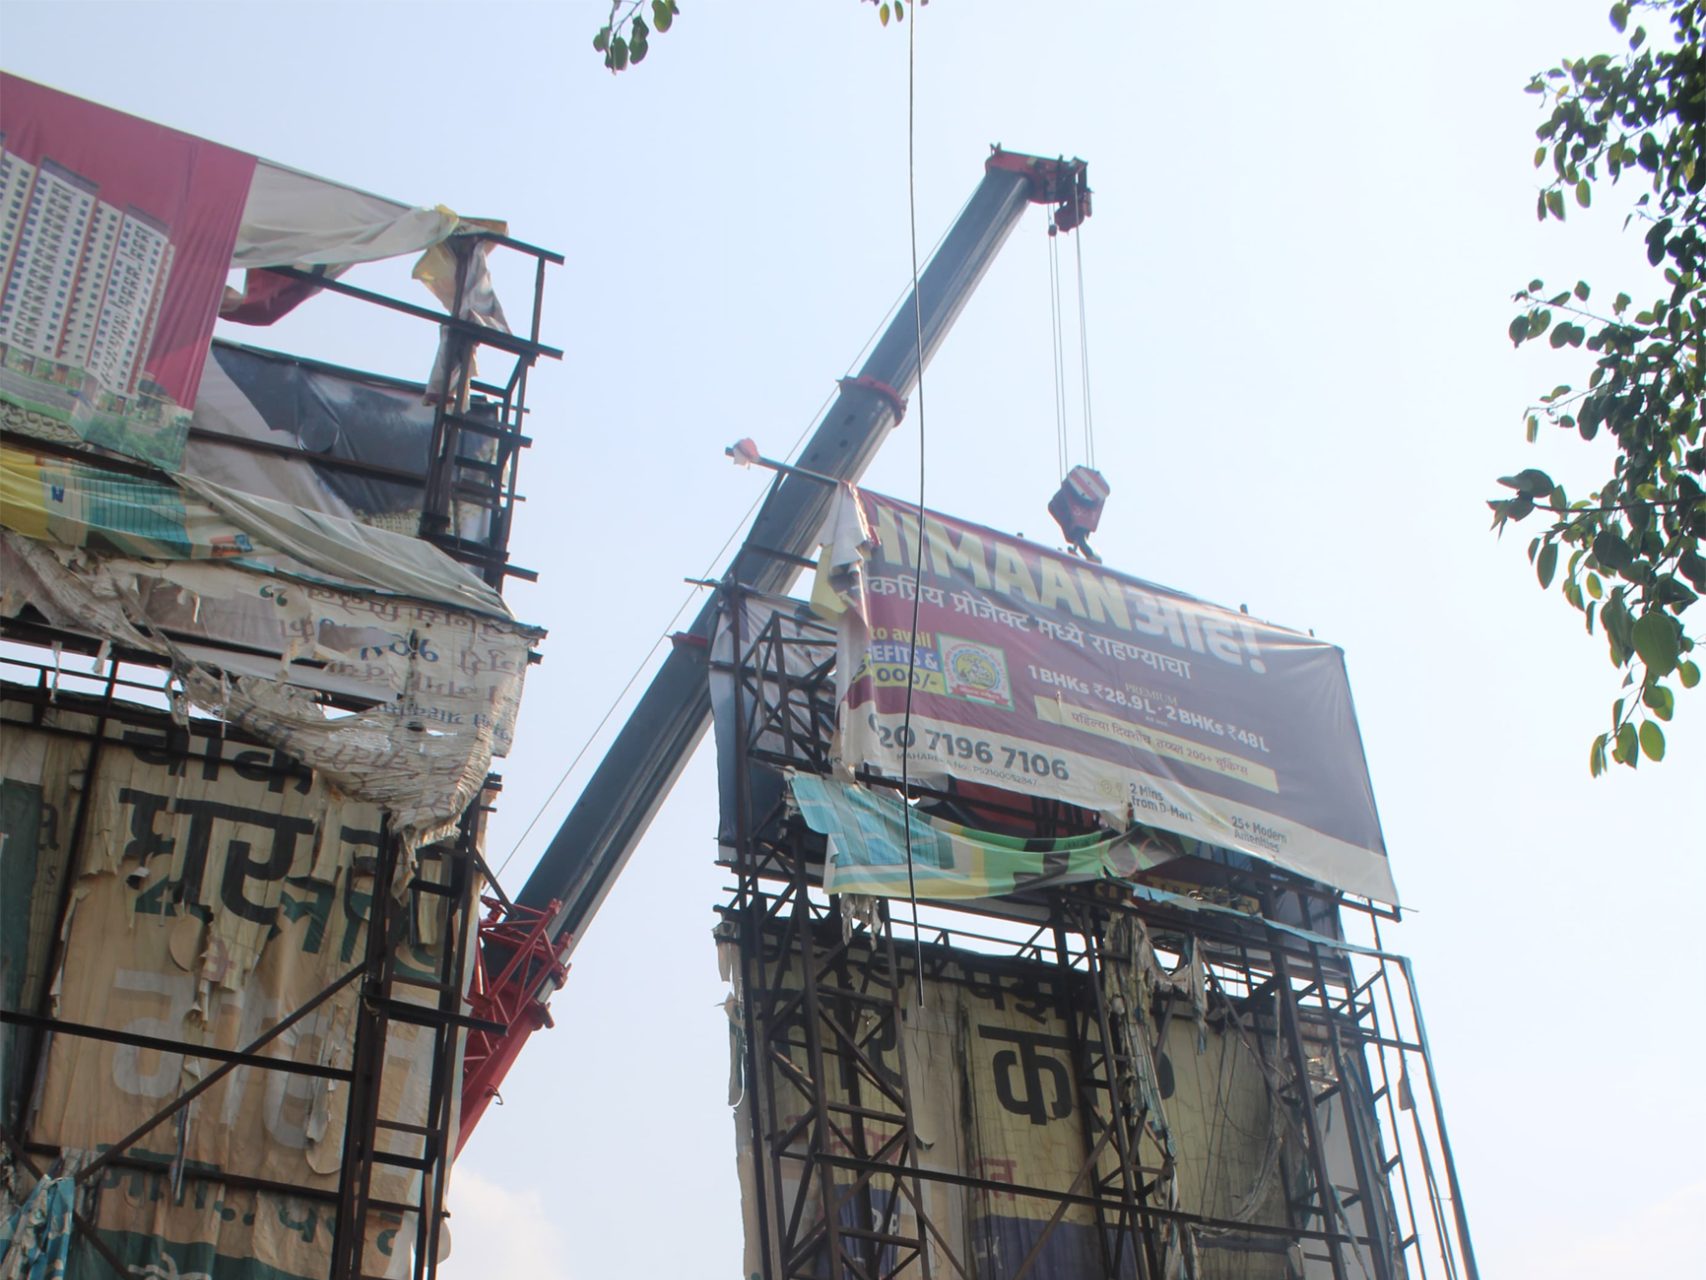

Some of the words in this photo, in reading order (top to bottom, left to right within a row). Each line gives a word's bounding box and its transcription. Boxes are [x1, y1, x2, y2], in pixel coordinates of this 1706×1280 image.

[1036, 616, 1087, 648] मध्ये
[1089, 632, 1192, 680] राहण्याचा
[924, 728, 994, 766] 7196
[999, 746, 1070, 782] 7106
